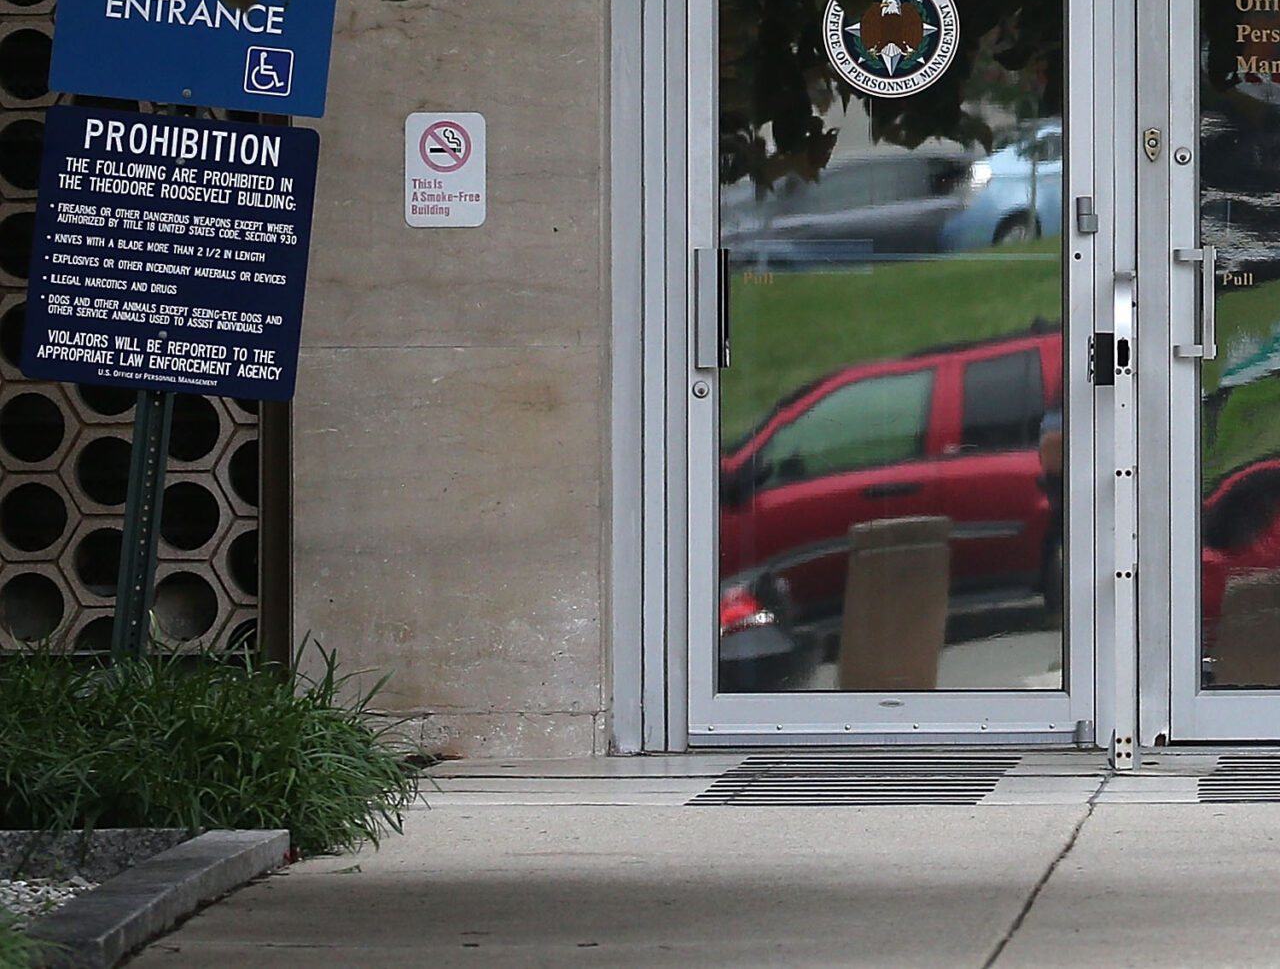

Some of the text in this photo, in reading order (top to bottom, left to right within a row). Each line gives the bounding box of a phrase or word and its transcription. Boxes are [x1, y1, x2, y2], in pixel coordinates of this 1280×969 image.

[830, 4, 953, 91] OFFICE OF PERSONNEL MANAGEMENT
[84, 118, 281, 167] PROHIBITION
[66, 157, 293, 192] THE FOLLOWING ARE PROHIBITED IN
[412, 179, 442, 189] This Is
[59, 174, 296, 210] THE THEODORE ROOSEVELT BUILDING:
[412, 192, 480, 202] A Smoke-Free
[58, 203, 294, 234] FIREARMS OR OTHER DANGEROUS WEAPONS EXCEPT WHERE
[412, 205, 450, 216] Building
[57, 214, 104, 226] AUTHORIZED
[108, 218, 119, 227] BY
[123, 219, 143, 230] TITLE
[159, 223, 185, 234] UNITED
[189, 226, 215, 237] STATES
[245, 232, 276, 242] SECTION
[280, 235, 297, 245] 930
[54, 234, 82, 244] KNIVES
[87, 236, 104, 247] WITH
[108, 239, 114, 247] A
[118, 239, 144, 250] BLADE
[147, 242, 169, 253] MORE
[173, 244, 194, 255] THAN
[197, 247, 203, 256] 2
[224, 250, 232, 259] IN
[235, 251, 265, 262] LENGTH
[51, 274, 177, 294] ILLEGAL NARCOTICS AND DRUGS
[52, 254, 286, 285] EXPLOSIVES OR OTHER INCENDIARY MATERIALS OR DEVICES
[1222, 272, 1253, 285] Pull
[48, 294, 282, 325] DOGS AND OTHER ANIMALS EXCEPT SEEING-EYE DOGS AND
[48, 305, 263, 334] OTHER SERVICE ANIMALS USED TO ASSIST INDIVIDUALS
[37, 345, 282, 380] APPROPRIATE LAW ENFORCEMENT AGENCY
[48, 330, 275, 364] VIOLATORS WILL BE REPORTED TO THE
